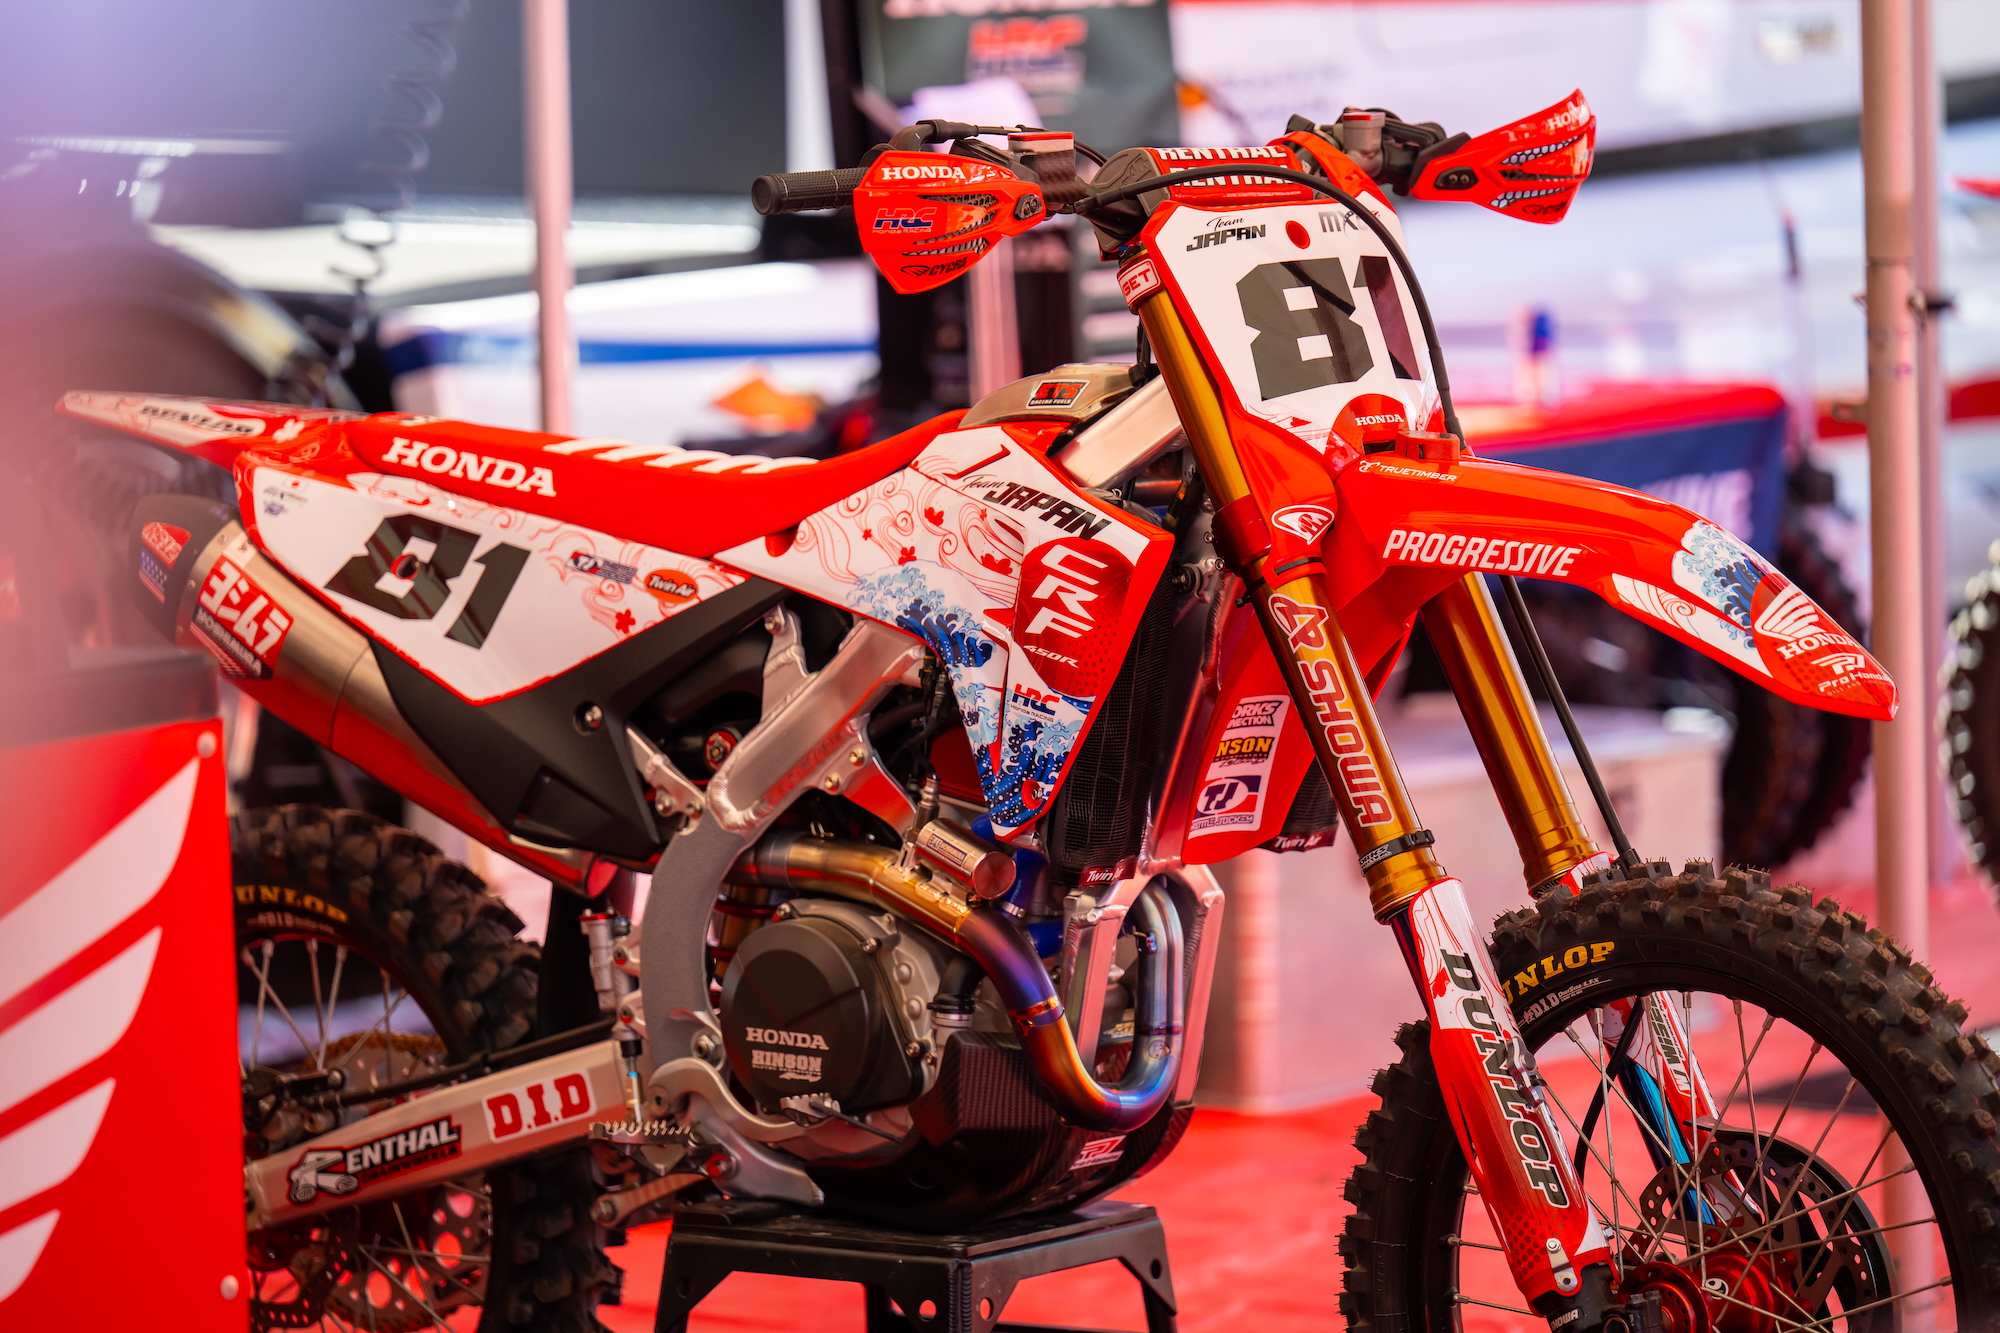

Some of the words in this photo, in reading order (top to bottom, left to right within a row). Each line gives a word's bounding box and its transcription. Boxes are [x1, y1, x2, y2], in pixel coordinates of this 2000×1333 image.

[1159, 145, 1287, 161] RENTHAL
[881, 166, 966, 180] HONDA
[873, 207, 937, 229] HRC
[1206, 215, 1245, 231] Team
[1186, 224, 1266, 251] JAPAN
[928, 257, 968, 276] CYCRA
[1236, 255, 1421, 401] 81
[1036, 383, 1082, 398] ETS
[1355, 414, 1404, 426] HONDA
[382, 437, 556, 497] HONDA
[1380, 464, 1458, 481] TRUETIMBER
[962, 474, 1004, 491] Team
[982, 481, 1112, 541] JAPAN
[1382, 529, 1582, 576] PROGRESSIVE
[324, 514, 531, 650] 81
[647, 575, 677, 593] Twin
[675, 583, 696, 597] Air
[1025, 544, 1108, 638] CRF
[1023, 645, 1079, 668] 450R
[1776, 632, 1860, 660] HONDA
[1012, 683, 1060, 716] HRC
[1231, 702, 1281, 718] ORKS
[1228, 714, 1273, 729] NECTION
[1298, 658, 1394, 828] SHOWA
[1203, 781, 1239, 812] TJ
[1216, 814, 1254, 827] JOCKEY
[1274, 835, 1305, 850] Twin
[1302, 833, 1323, 848] Air
[1086, 869, 1113, 883] Twin
[235, 885, 348, 923] UNLOP
[1500, 941, 1615, 1004] UNLOP
[745, 1027, 829, 1050] HONDA
[752, 1049, 822, 1071] HINSON
[1440, 948, 1569, 1208] DUNLOP
[487, 1073, 591, 1138] D.I.D
